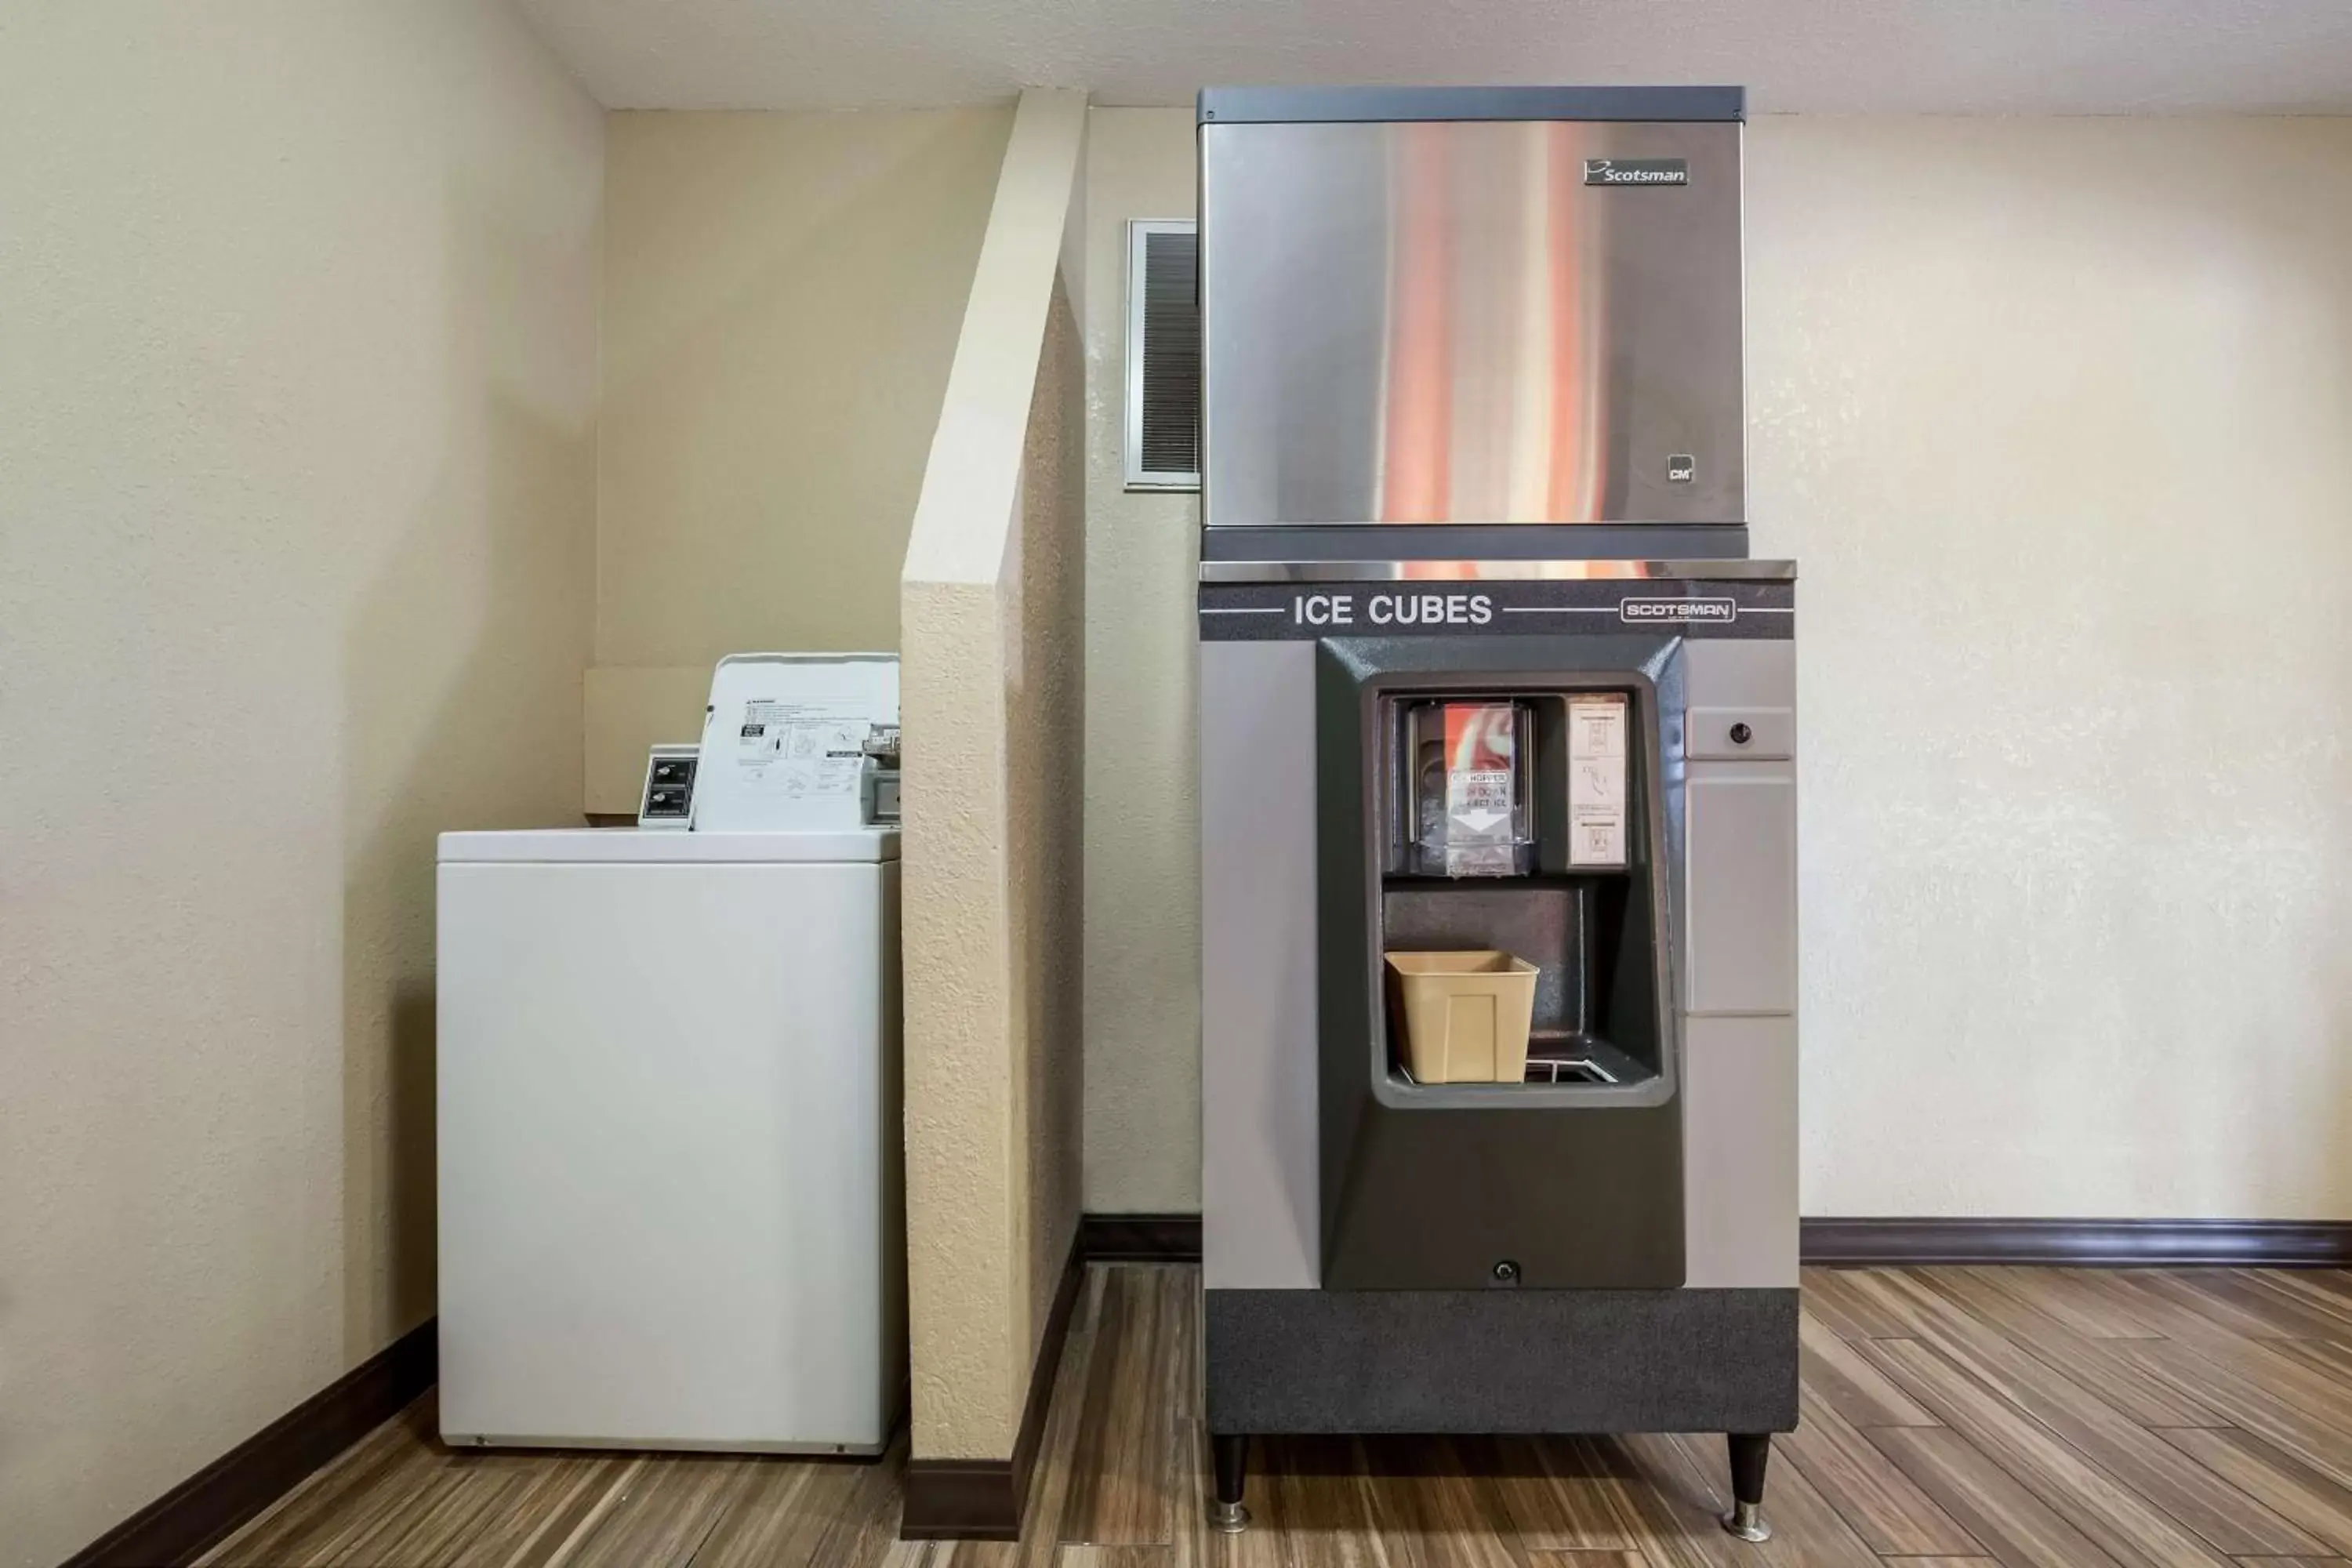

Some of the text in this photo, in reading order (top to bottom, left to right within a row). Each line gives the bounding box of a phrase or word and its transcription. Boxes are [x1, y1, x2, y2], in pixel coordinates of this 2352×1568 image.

[1605, 169, 1685, 182] Scotsman
[1295, 595, 1493, 625] ICE CUBES
[1627, 604, 1730, 615] SCOTSMAN
